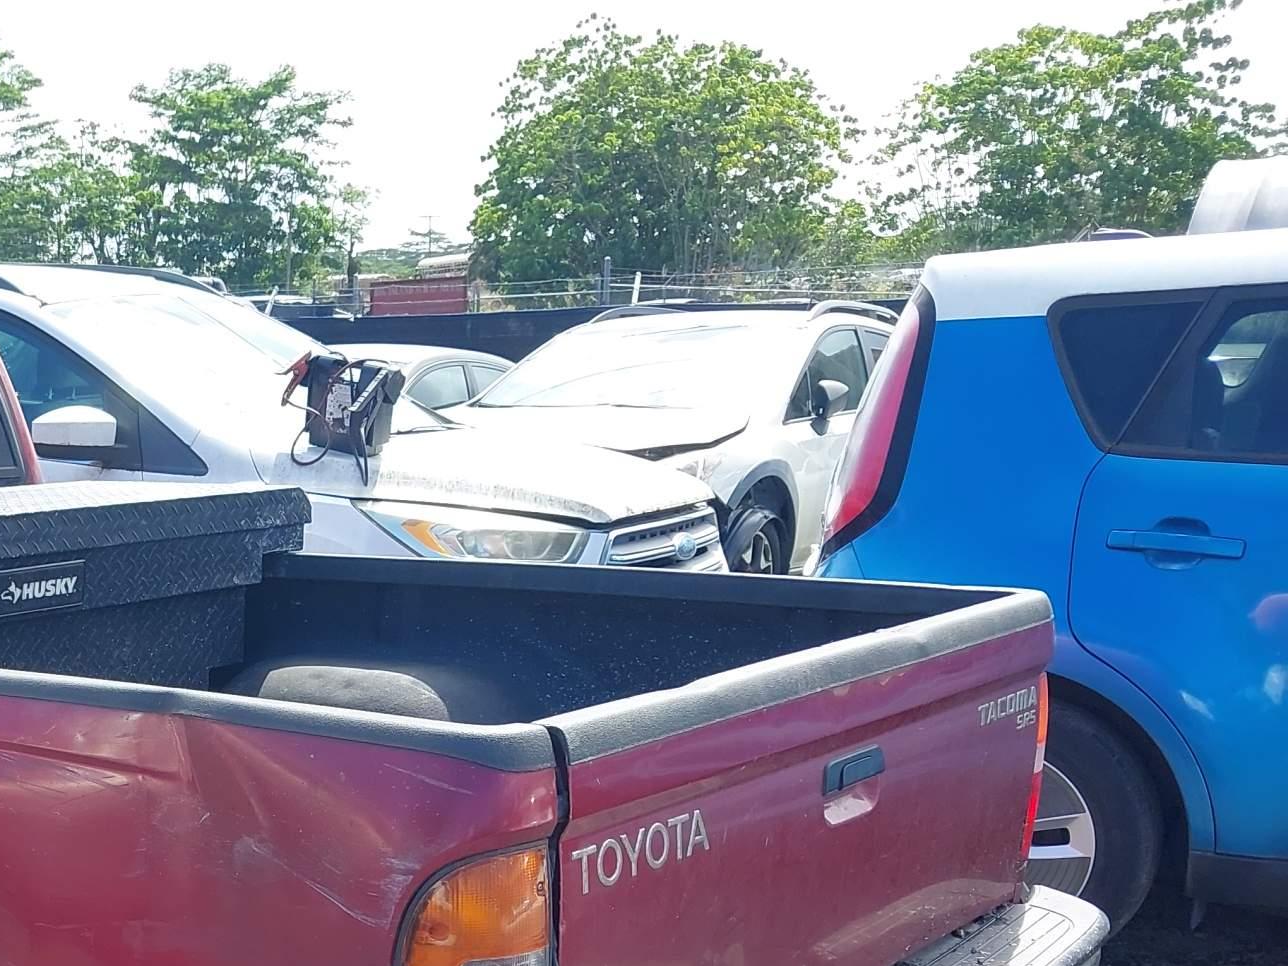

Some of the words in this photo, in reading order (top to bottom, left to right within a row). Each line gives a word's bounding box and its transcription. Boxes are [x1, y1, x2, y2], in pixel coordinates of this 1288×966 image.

[21, 576, 77, 600] HUSKY
[977, 686, 1037, 726] TACOMA
[571, 809, 710, 895] TOYOTA
